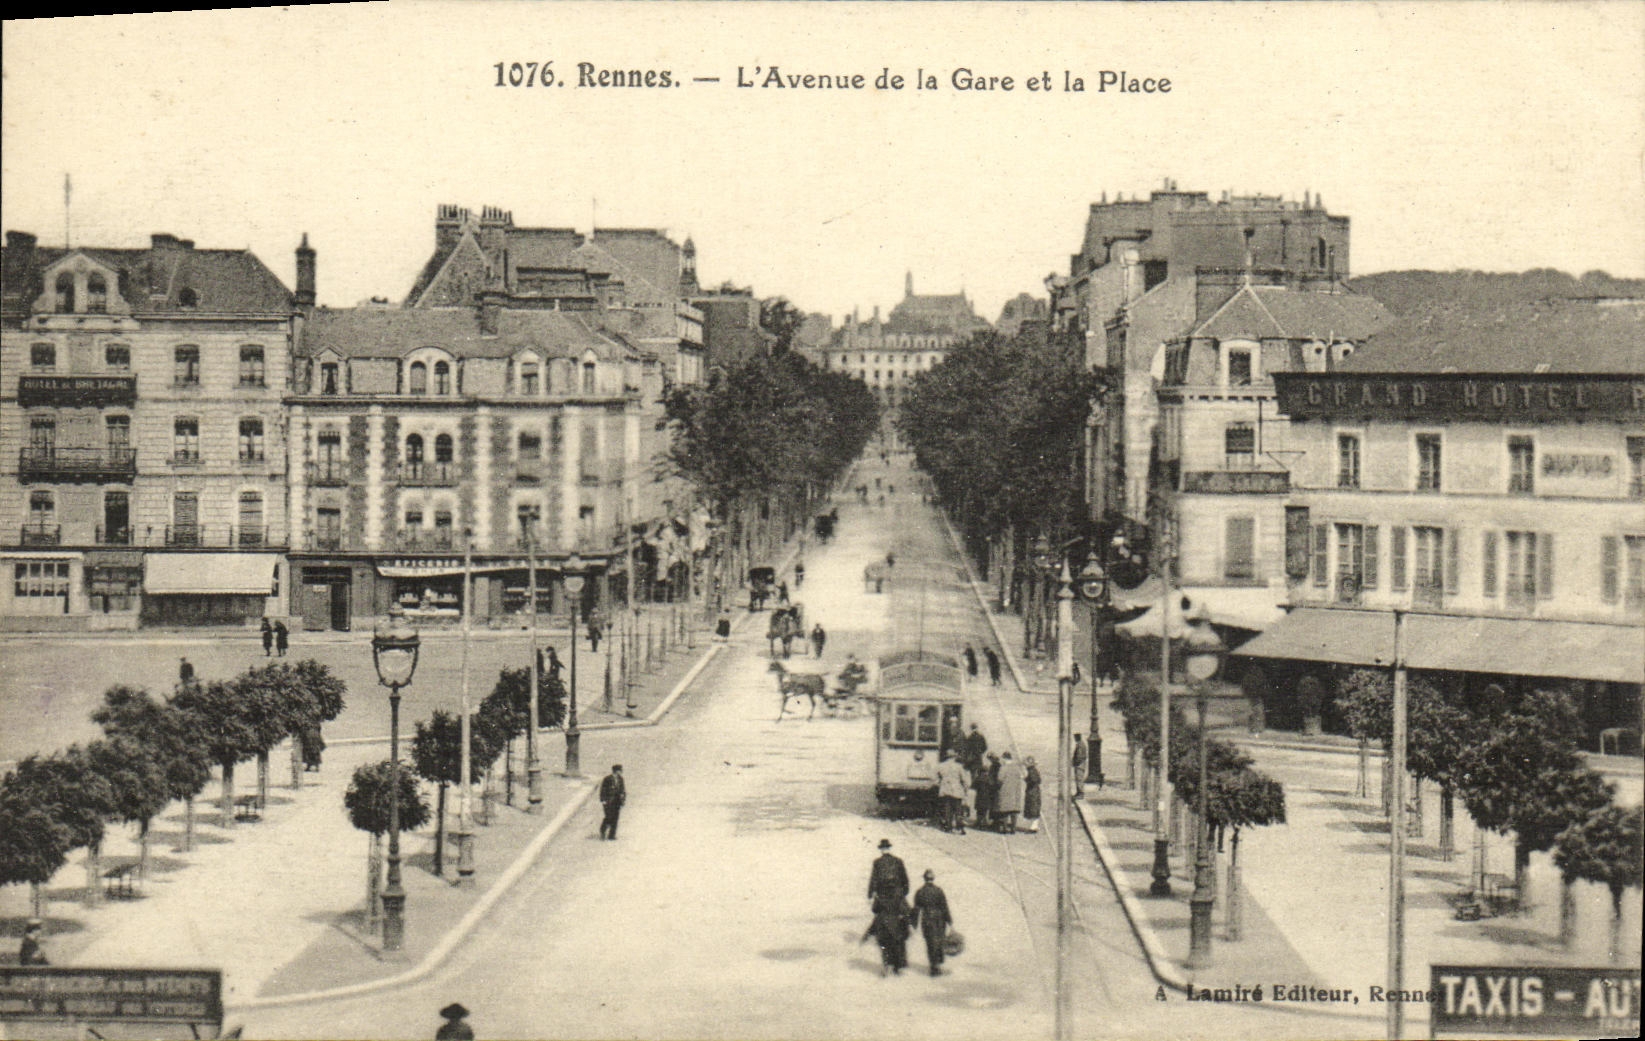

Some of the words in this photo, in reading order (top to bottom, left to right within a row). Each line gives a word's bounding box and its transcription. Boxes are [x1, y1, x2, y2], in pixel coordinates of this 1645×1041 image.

[1307, 382, 1428, 407] GRAND
[1463, 384, 1594, 409] HOTEL
[1440, 975, 1543, 1017] TAXIS
